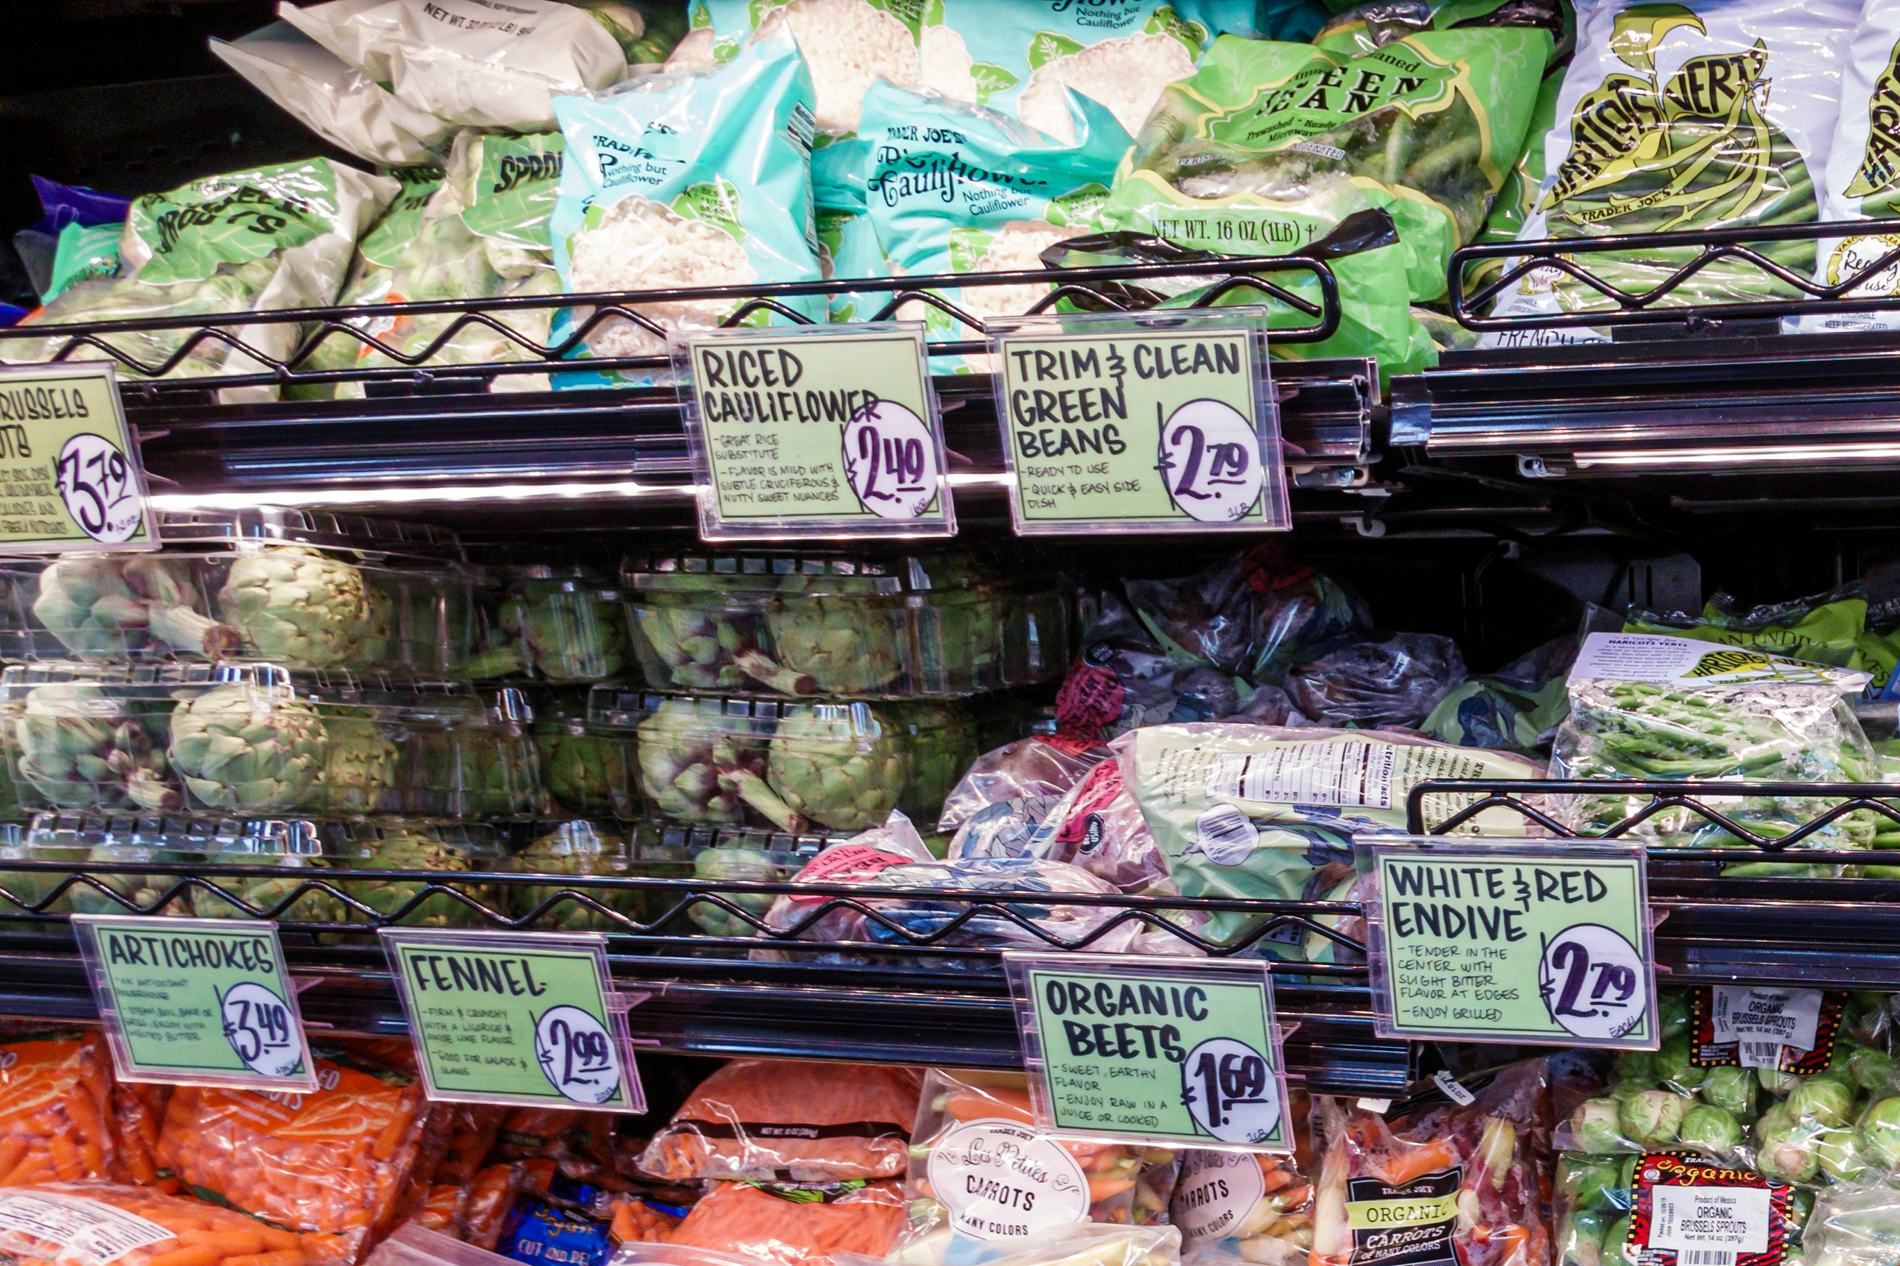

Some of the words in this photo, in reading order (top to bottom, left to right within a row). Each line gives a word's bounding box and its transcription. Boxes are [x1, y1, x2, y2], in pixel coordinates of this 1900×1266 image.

[1152, 220, 1179, 239] NET
[1184, 221, 1210, 241] WT.
[1216, 220, 1233, 242] 16
[1238, 220, 1257, 242] OZ
[1261, 219, 1299, 244] (1LB)
[704, 349, 802, 386] RICED
[1011, 350, 1101, 382] TRIM
[1134, 342, 1240, 376] CLEAN
[707, 389, 880, 424] CAULIFLOWER
[1013, 389, 1128, 425] GREEN
[1021, 425, 1128, 459] BEANS
[1389, 866, 1505, 901] WHITE
[1537, 870, 1608, 903] RED
[1392, 903, 1528, 942] ENDIVE
[109, 934, 275, 973] ARTICHOKES
[409, 955, 545, 997] FENNEL
[1401, 988, 1447, 999] FLAVOR
[1476, 989, 1519, 1000] EDGES
[1048, 981, 1208, 1021] ORGANIC
[1064, 1021, 1186, 1062] BEETS
[966, 1175, 1036, 1212] CARROTS
[1367, 1204, 1448, 1224] ORGANIC
[1681, 1218, 1715, 1232] BRUSSELS
[1717, 1220, 1747, 1234] SPROUTS
[1696, 1207, 1733, 1219] ORGANIC
[1367, 1227, 1444, 1249] CARROTS
